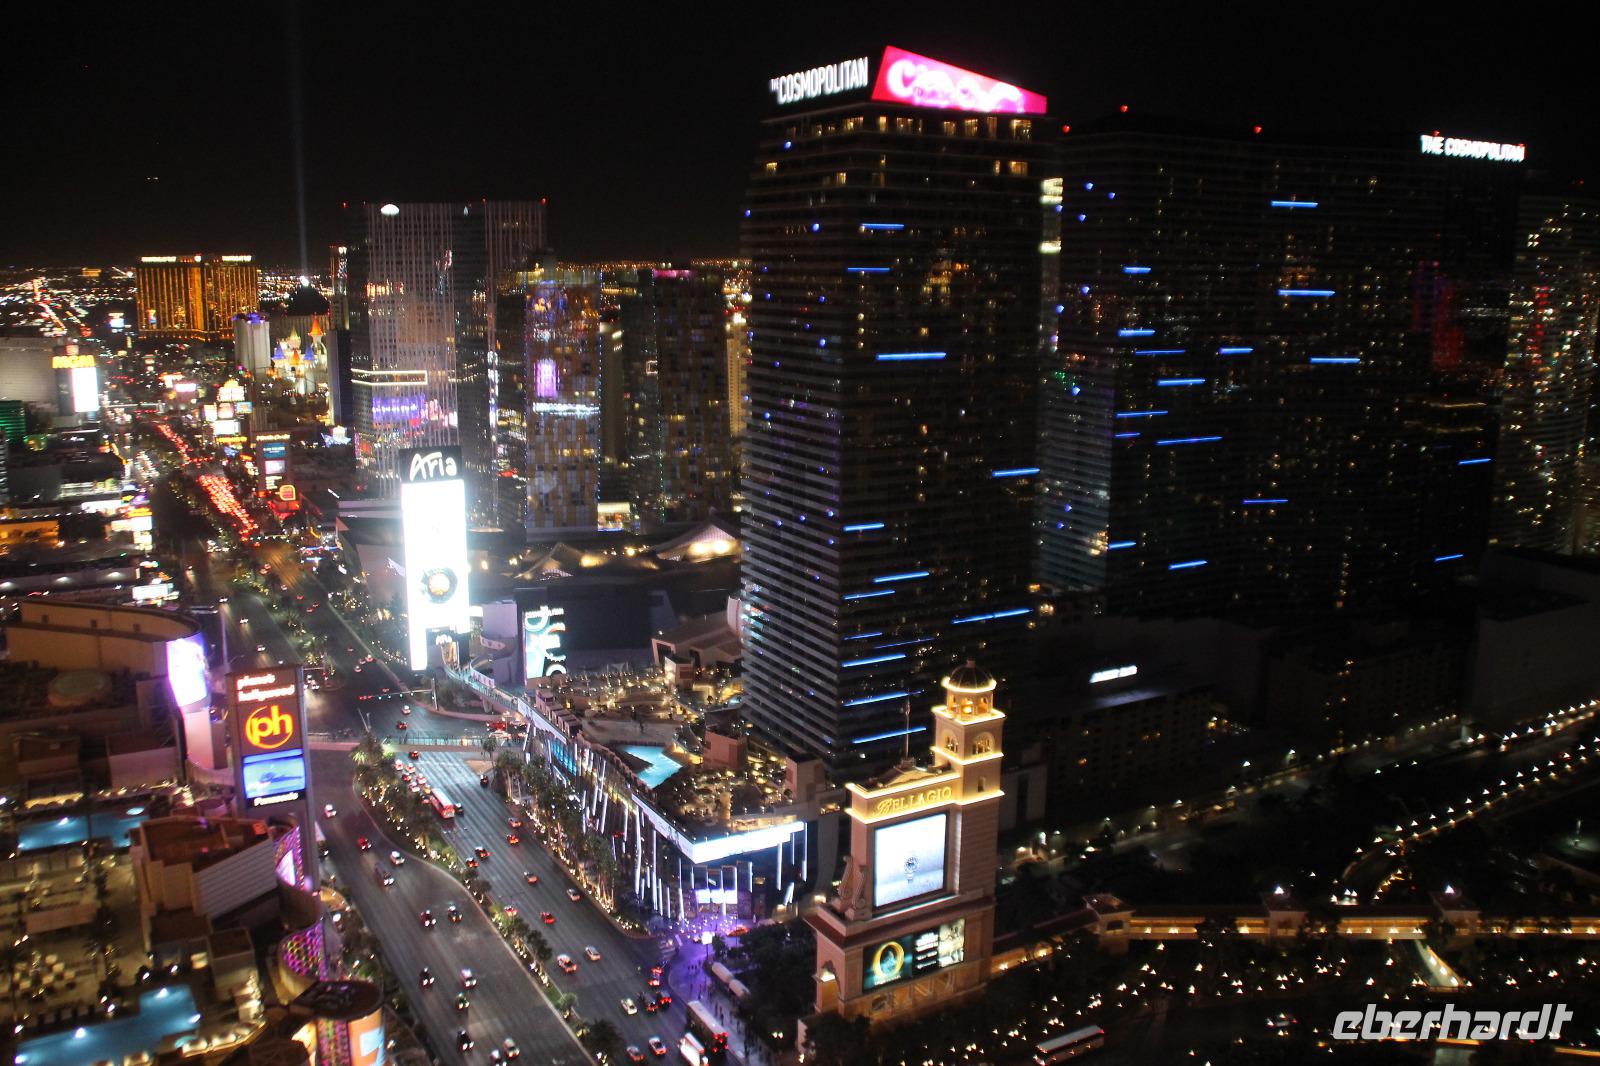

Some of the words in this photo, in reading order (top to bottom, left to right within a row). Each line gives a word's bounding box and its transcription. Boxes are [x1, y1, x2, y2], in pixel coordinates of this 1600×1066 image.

[777, 56, 869, 105] COSMOPOLITAN
[1420, 134, 1444, 155] THE
[1444, 137, 1525, 162] COSMOPOLITAN
[251, 705, 293, 746] ph
